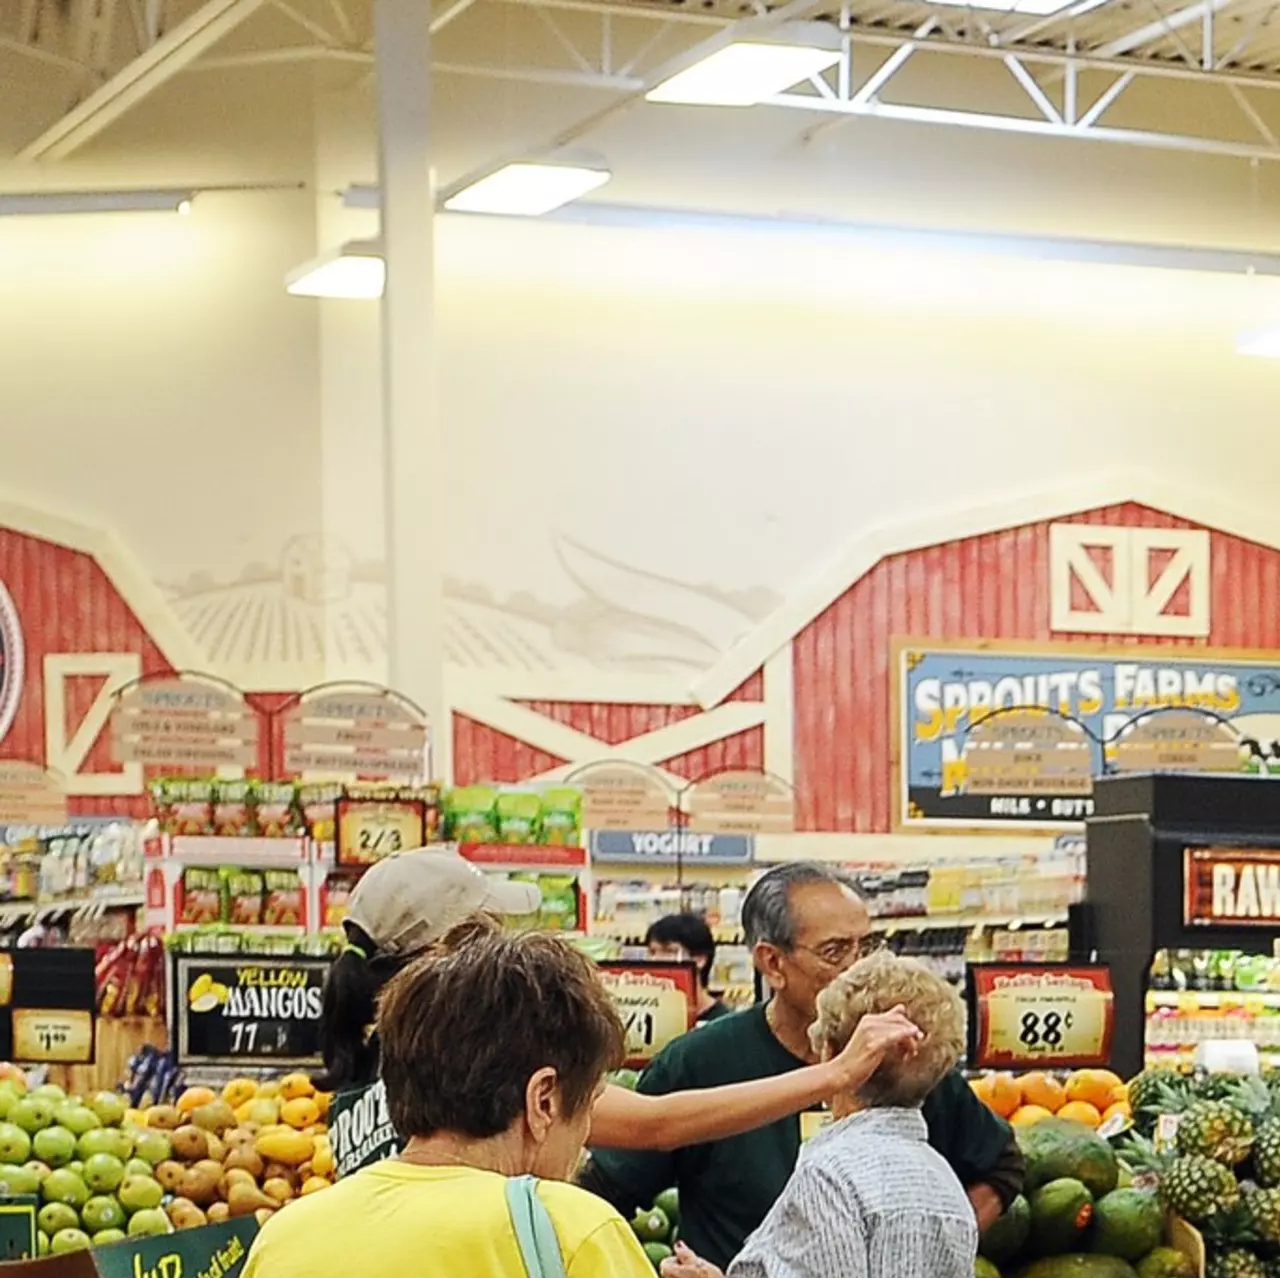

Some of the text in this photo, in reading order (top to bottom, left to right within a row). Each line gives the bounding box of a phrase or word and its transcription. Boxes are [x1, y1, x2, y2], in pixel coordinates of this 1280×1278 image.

[914, 669, 1104, 743] SPROUTS
[1113, 663, 1241, 712] FARMS
[236, 967, 309, 988] YELLOW
[222, 986, 323, 1019] MANGOS
